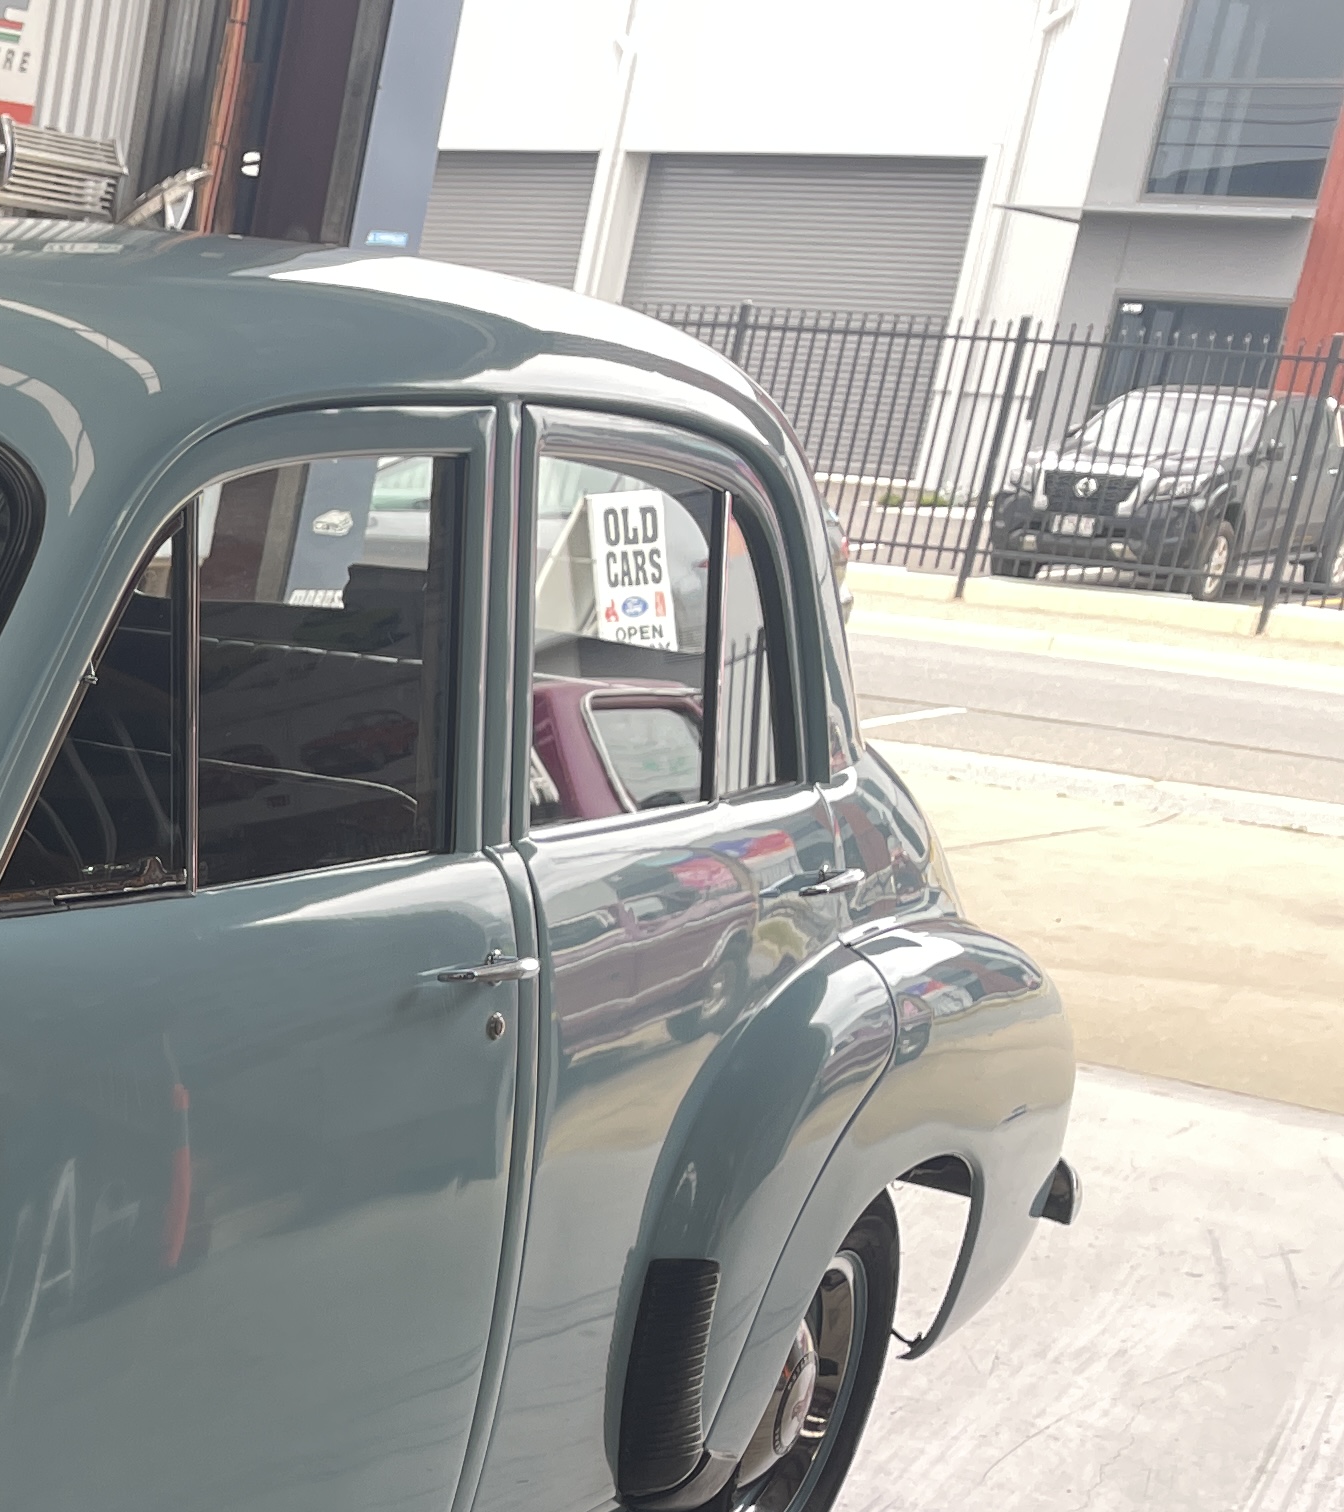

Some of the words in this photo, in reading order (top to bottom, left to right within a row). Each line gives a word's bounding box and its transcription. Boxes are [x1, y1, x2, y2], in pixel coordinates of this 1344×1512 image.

[603, 505, 659, 547] OLD
[605, 547, 663, 588] CARS
[615, 624, 664, 643] OPEN
